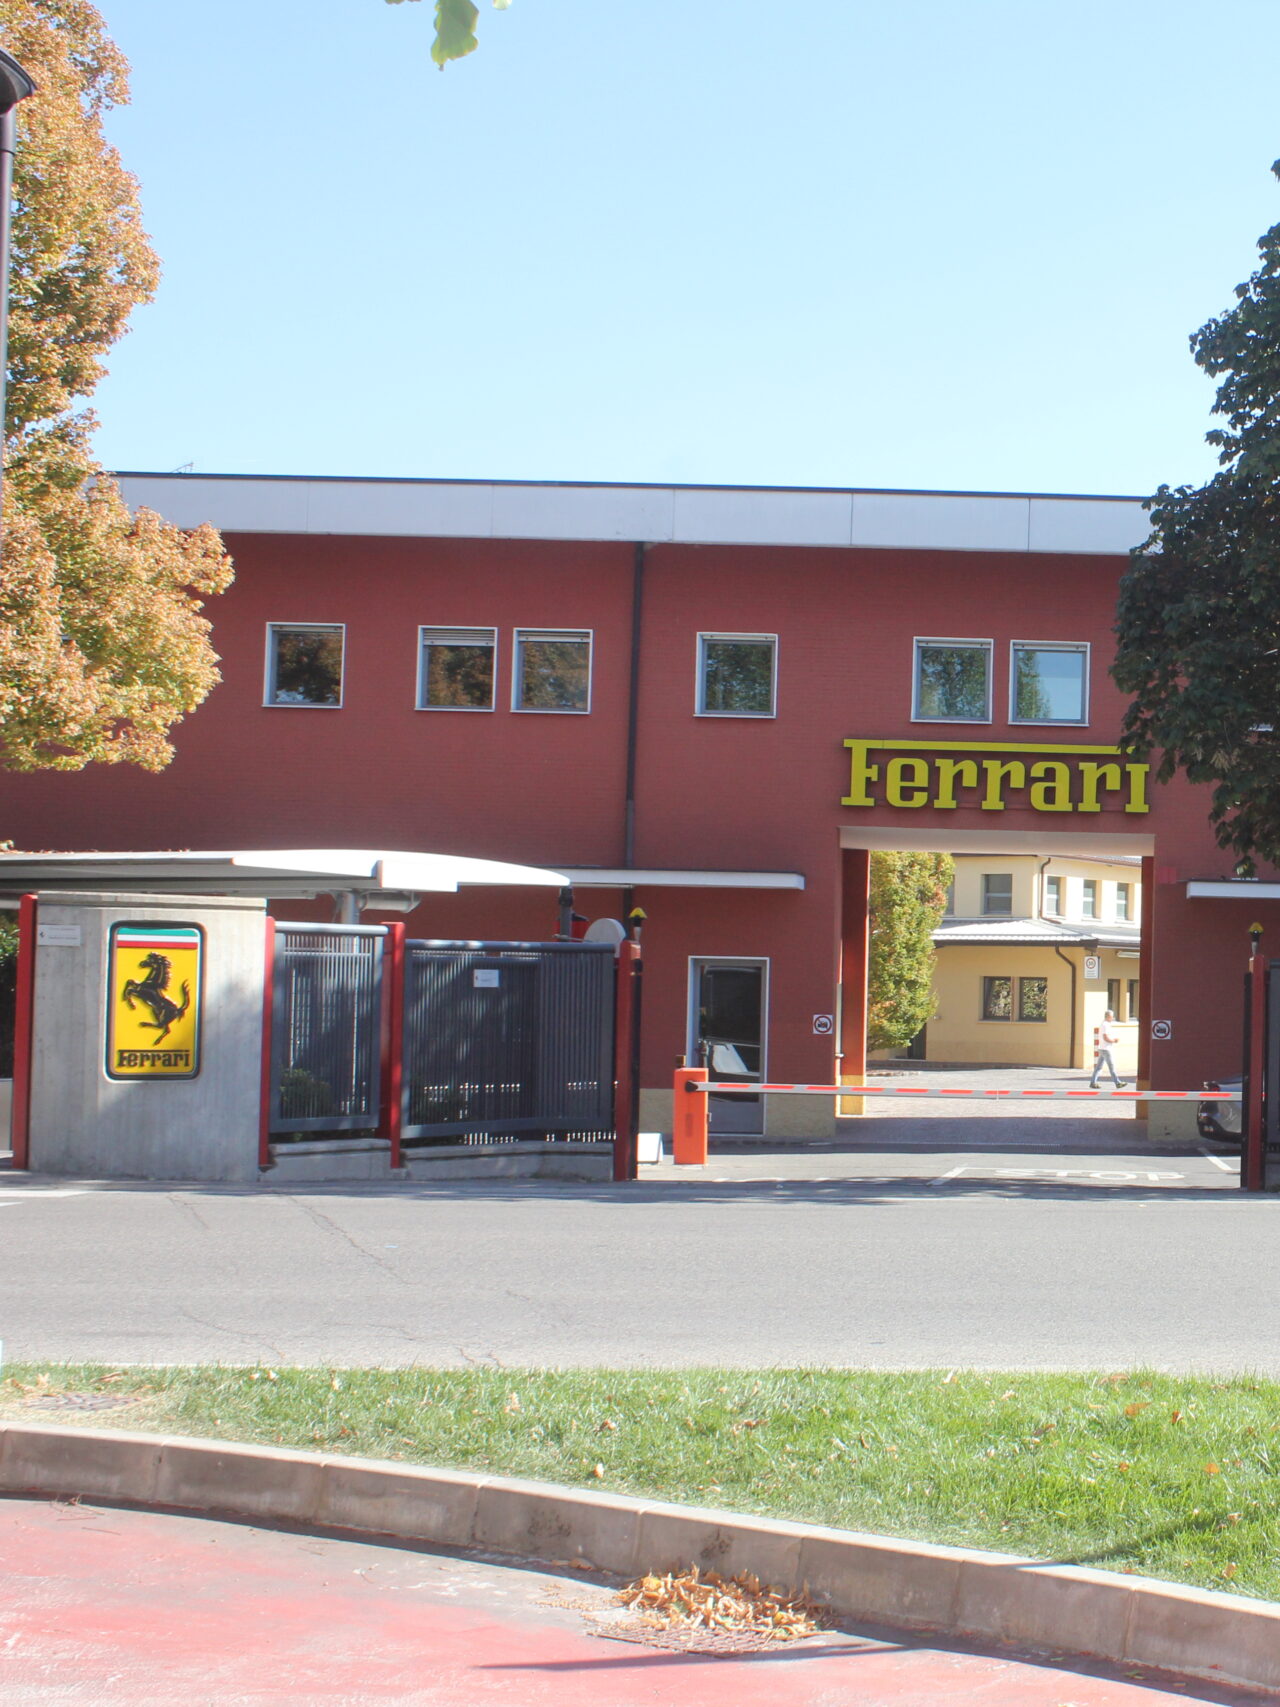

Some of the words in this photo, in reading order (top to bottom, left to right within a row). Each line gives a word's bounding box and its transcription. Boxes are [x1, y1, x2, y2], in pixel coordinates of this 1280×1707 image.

[841, 738, 1150, 813] Ferrari
[117, 1049, 190, 1067] Ferrari
[995, 1169, 1185, 1182] STOP
